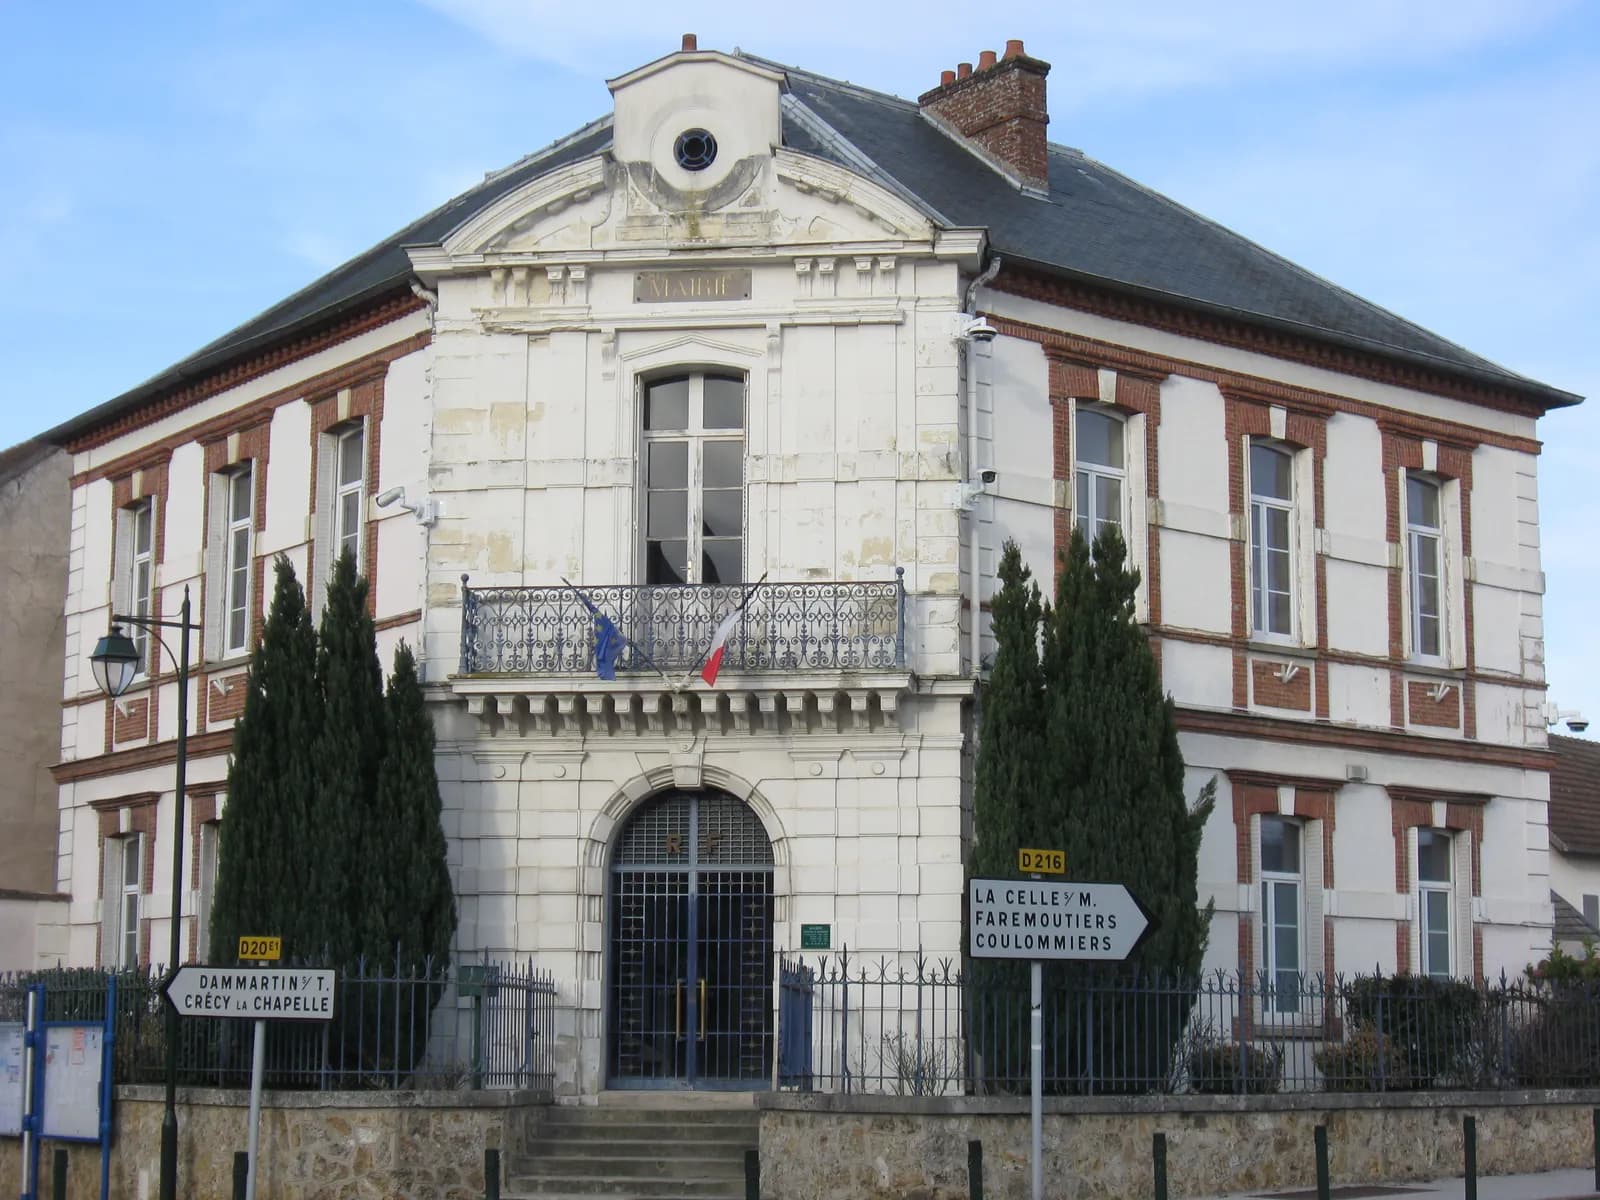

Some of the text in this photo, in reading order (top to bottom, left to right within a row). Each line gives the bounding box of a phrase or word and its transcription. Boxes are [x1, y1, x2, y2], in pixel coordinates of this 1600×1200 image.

[975, 888, 995, 904] LA
[1006, 890, 1059, 906] CELLE
[975, 911, 1117, 929] FAREMOUTIERS
[976, 933, 1112, 951] COULOMMIERS
[200, 975, 298, 991] DAMMARTIN
[185, 991, 329, 1012] CRÉCY LA CHAPELLE
